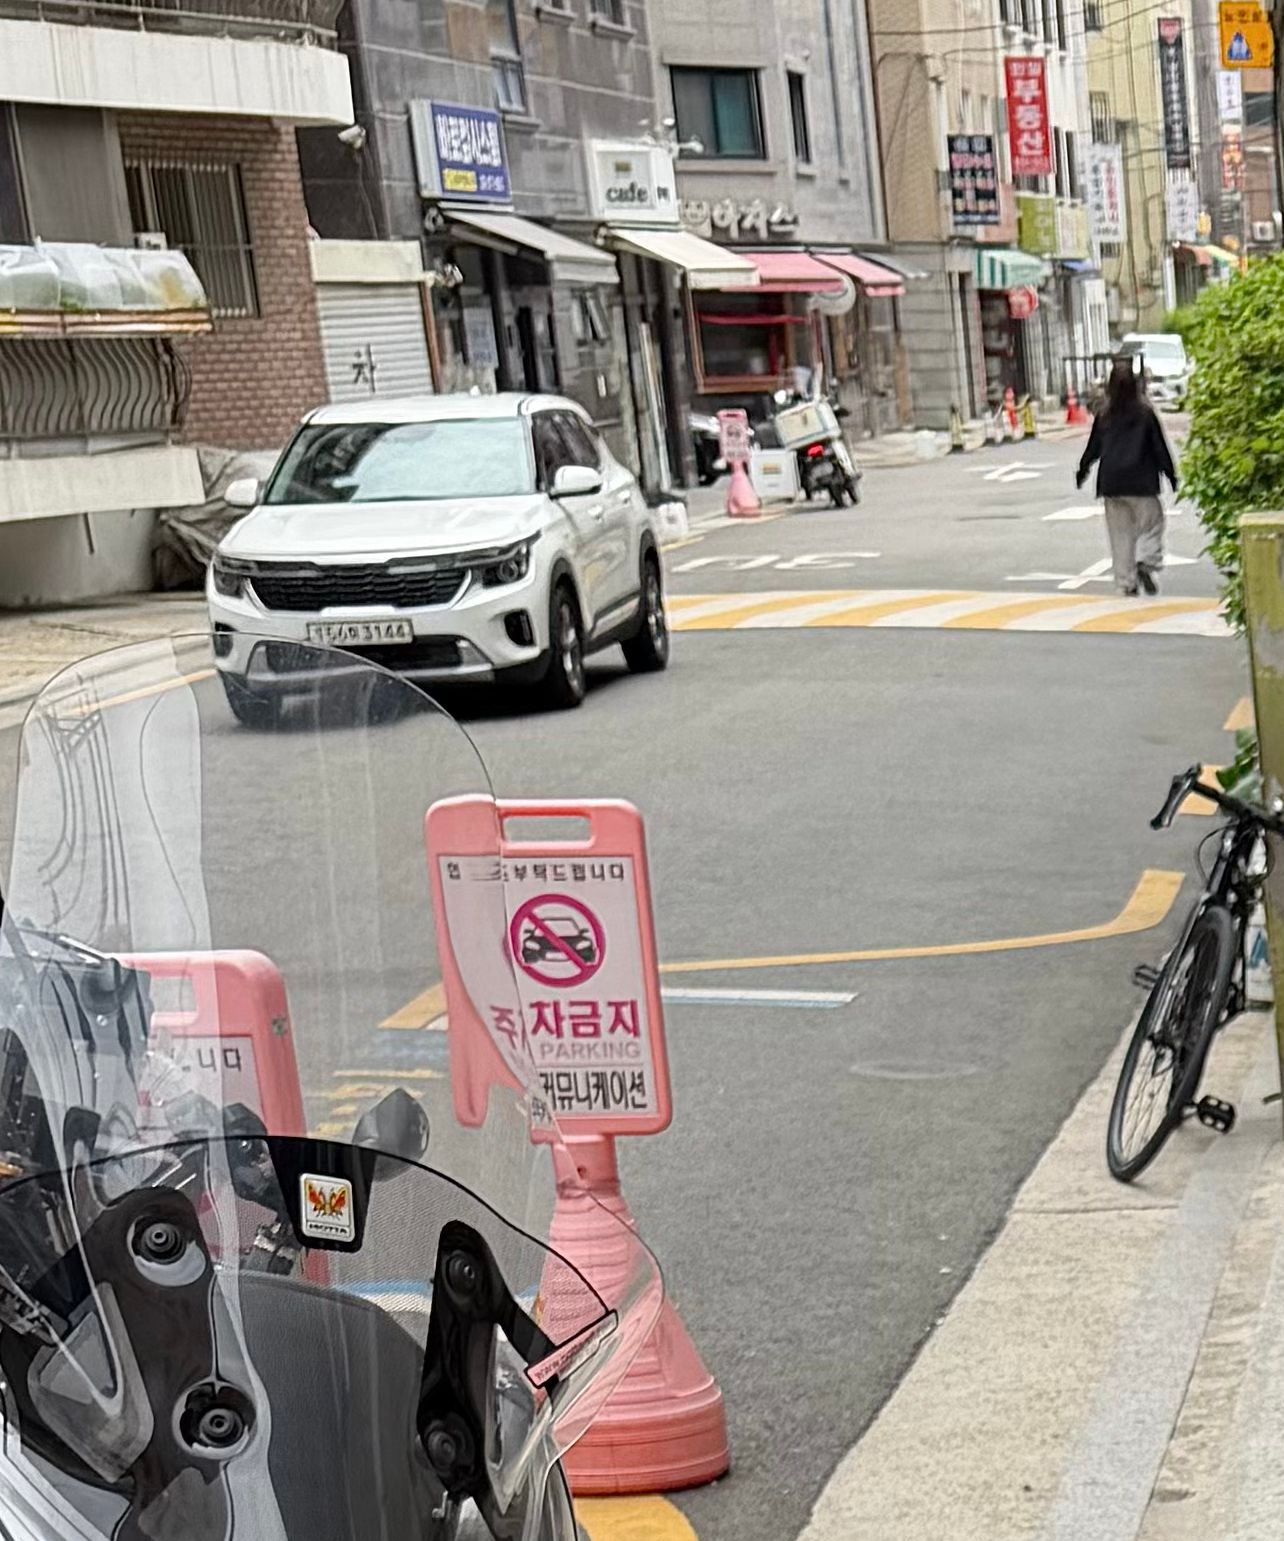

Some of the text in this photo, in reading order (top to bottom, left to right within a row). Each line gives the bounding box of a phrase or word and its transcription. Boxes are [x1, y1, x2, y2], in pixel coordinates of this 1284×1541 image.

[1012, 78, 1044, 156] 부동산
[352, 343, 376, 393] 차
[540, 1040, 641, 1060] PARKING
